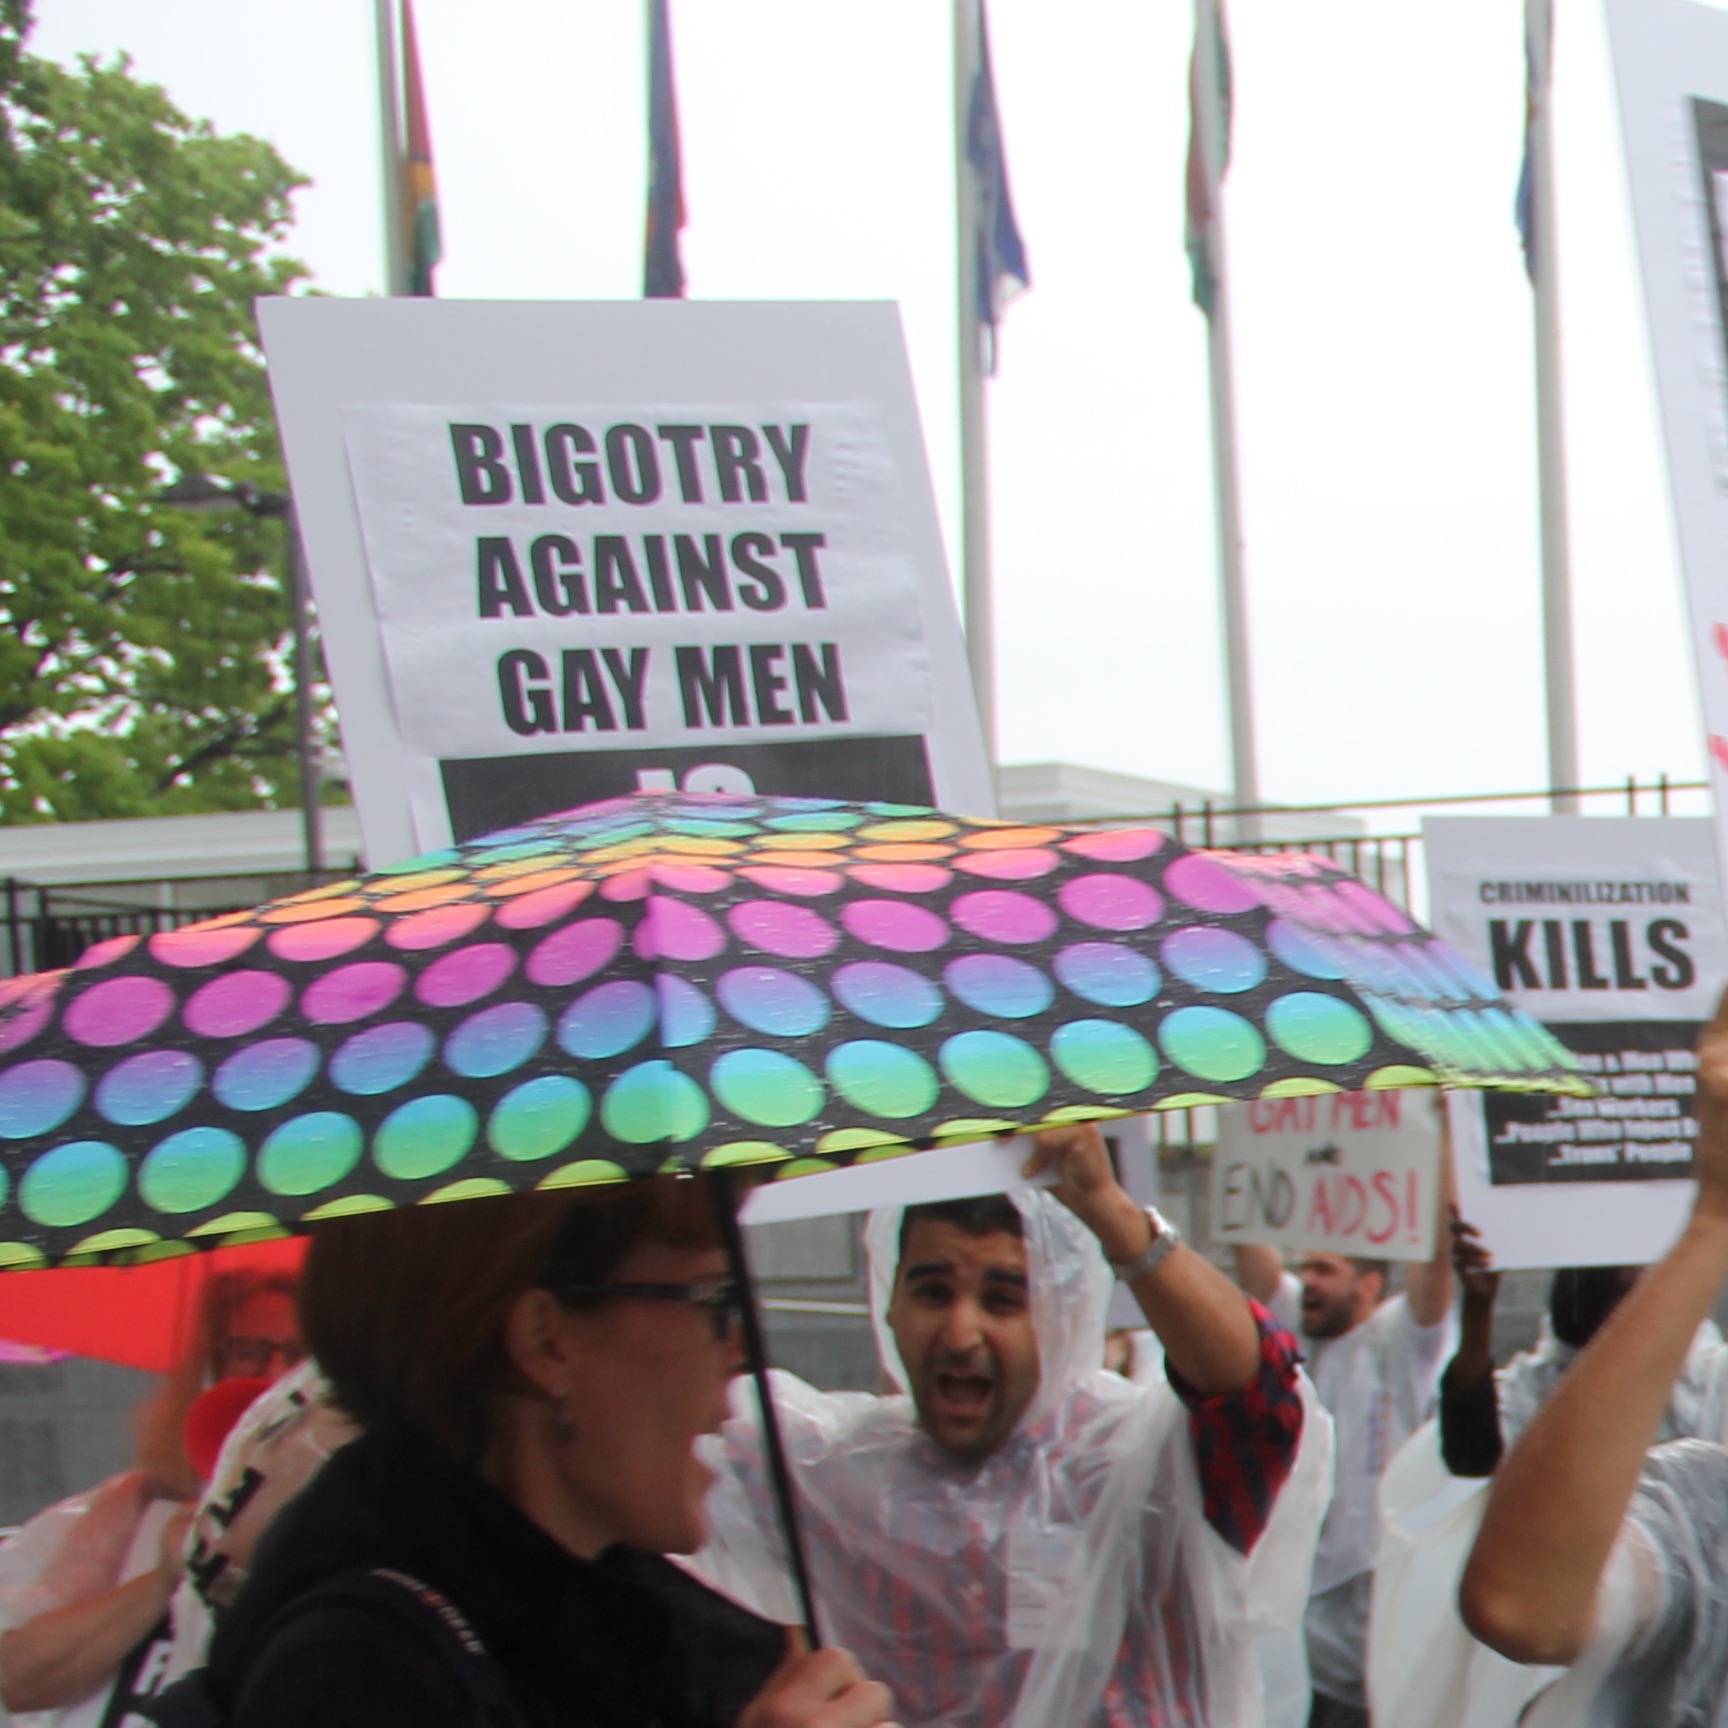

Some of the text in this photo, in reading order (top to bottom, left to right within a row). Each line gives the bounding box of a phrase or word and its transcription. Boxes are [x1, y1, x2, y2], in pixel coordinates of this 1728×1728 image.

[449, 422, 811, 505] BIGOTRY
[475, 531, 826, 618] AGAINST
[496, 641, 849, 737] GAY MEN
[1487, 918, 1696, 992] KILLS
